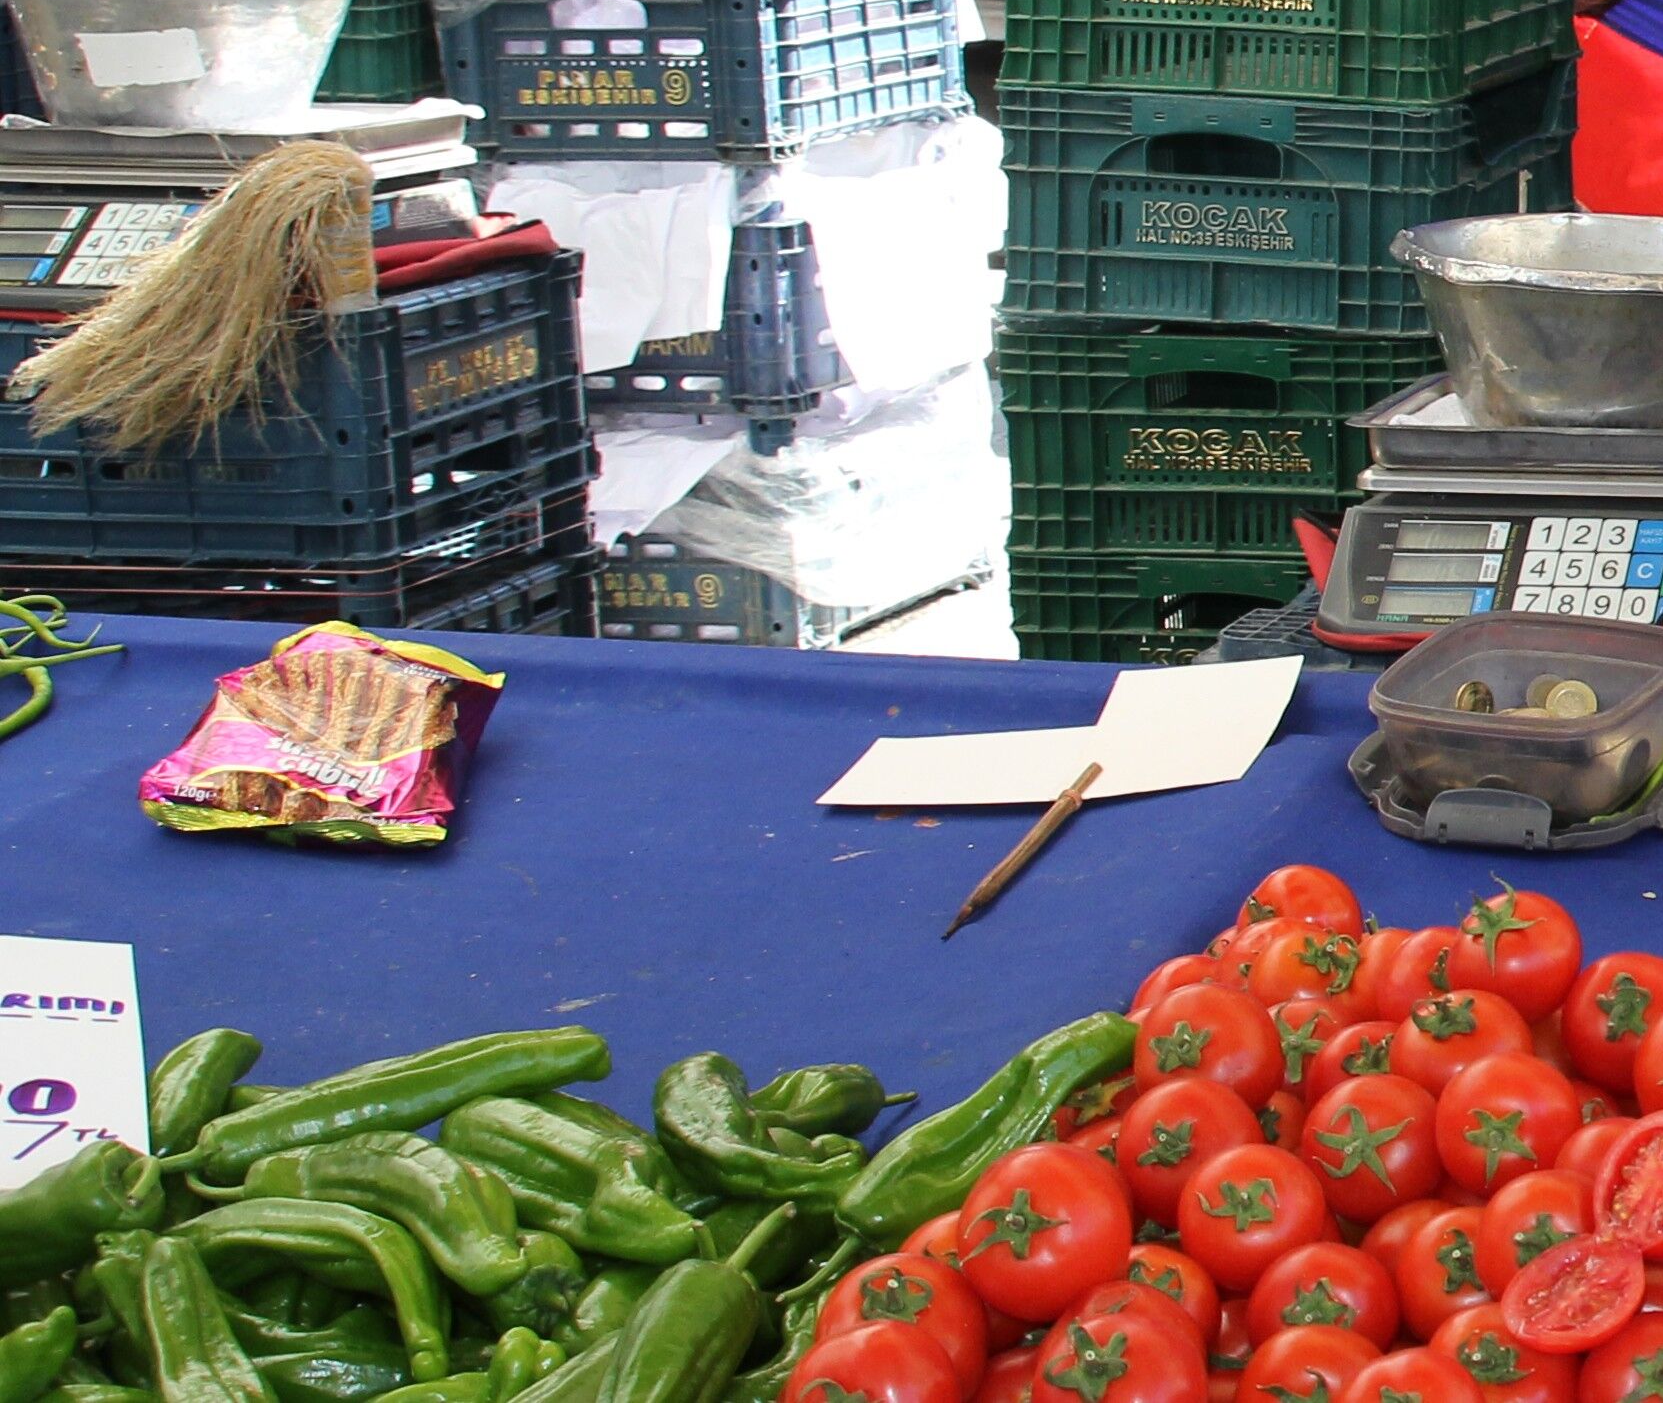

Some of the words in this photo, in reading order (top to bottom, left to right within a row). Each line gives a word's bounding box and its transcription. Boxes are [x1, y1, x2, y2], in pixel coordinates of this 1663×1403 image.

[661, 69, 692, 106] 9
[107, 209, 119, 225] 1
[130, 209, 146, 225] 2
[86, 235, 105, 251] 4
[113, 235, 131, 251] 5
[141, 236, 157, 252] 6
[1135, 228, 1167, 244] HAL
[1169, 229, 1213, 246] NO:35
[70, 262, 90, 278] 7
[96, 263, 114, 279] 8
[1122, 455, 1161, 470] HAL
[1541, 524, 1553, 544] 1
[1572, 524, 1592, 545] 2
[1608, 525, 1626, 546] 3
[1529, 558, 1547, 579] 4
[1564, 558, 1584, 579] 5
[1601, 559, 1619, 580] 6
[1636, 562, 1655, 579] C
[603, 573, 668, 591] NAR
[693, 573, 724, 609] 9
[1524, 593, 1540, 612] 7
[1557, 594, 1575, 615] 8
[1593, 595, 1611, 616] 9
[1630, 596, 1646, 616] 0
